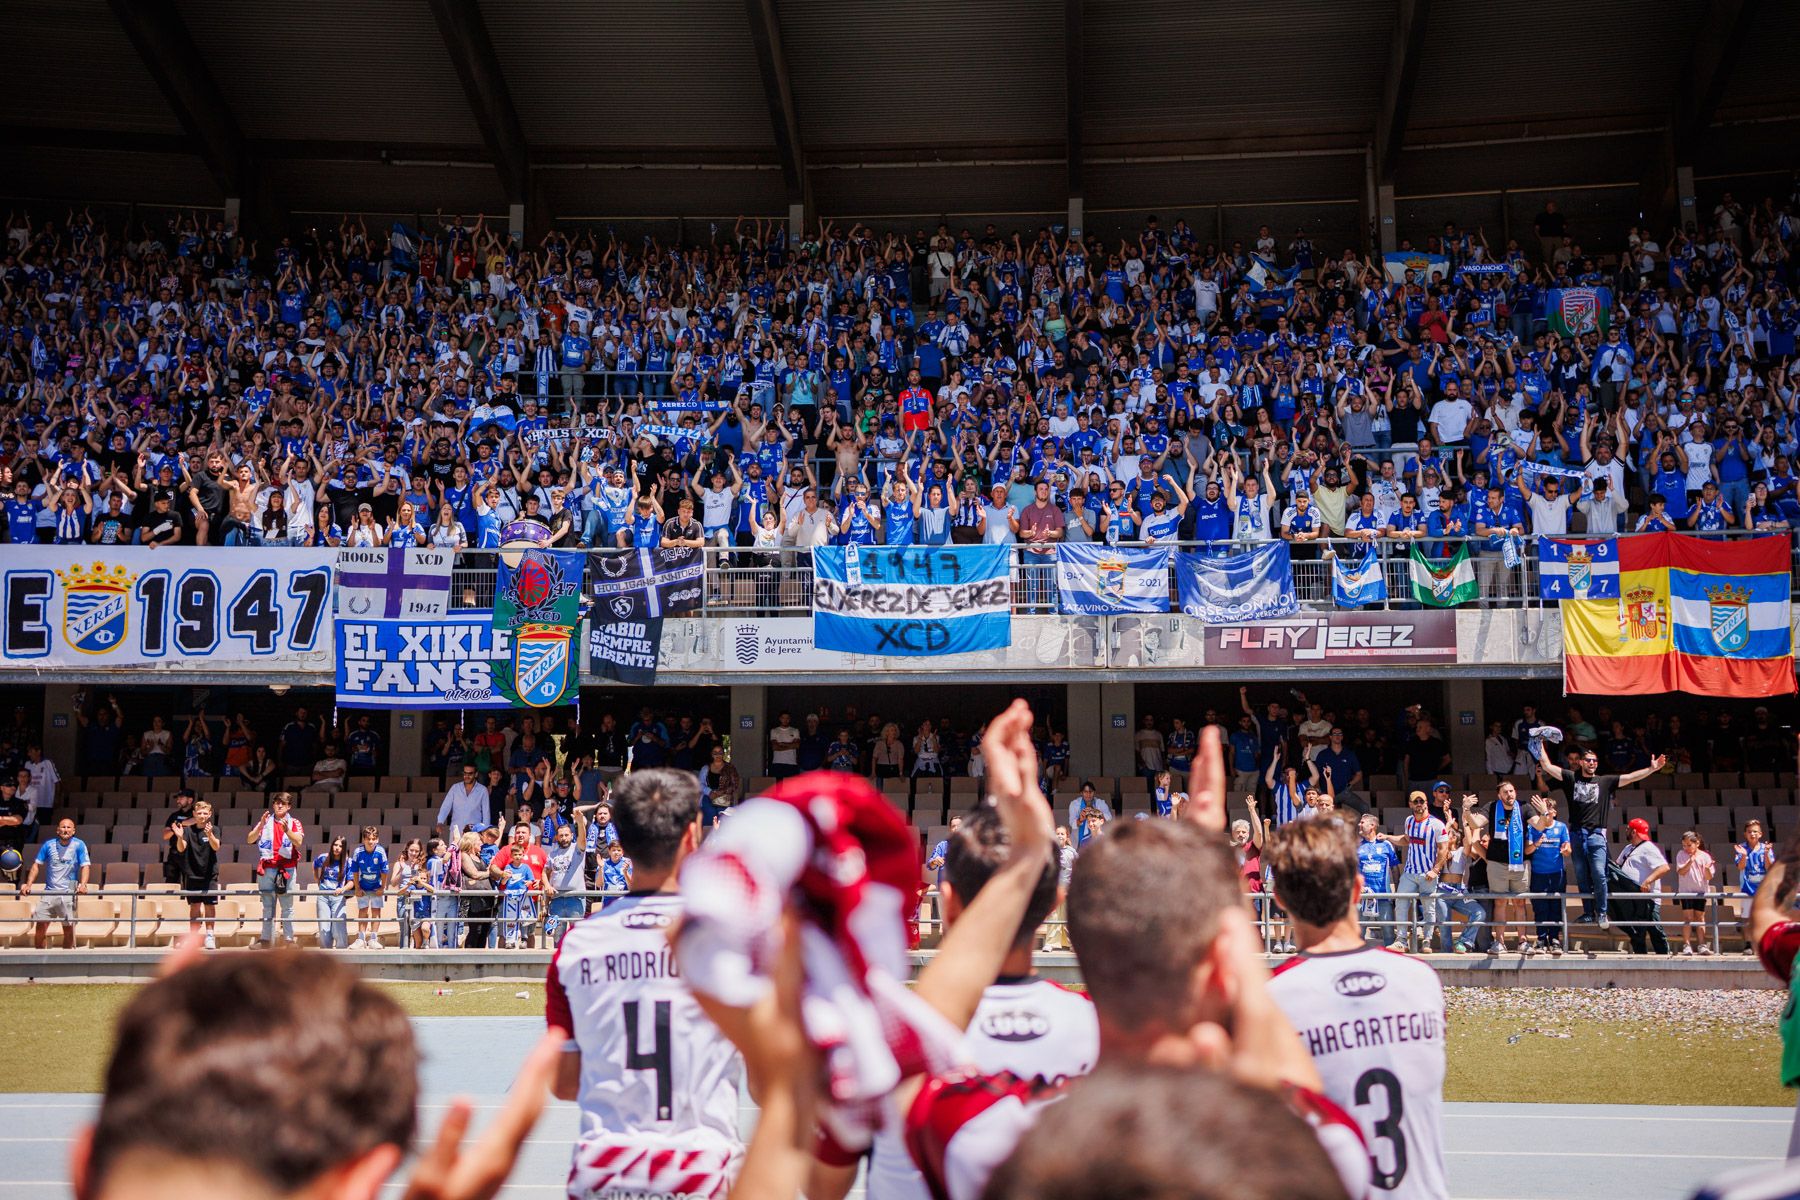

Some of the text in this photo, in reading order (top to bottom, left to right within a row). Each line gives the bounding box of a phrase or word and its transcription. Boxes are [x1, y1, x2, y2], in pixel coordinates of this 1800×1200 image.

[415, 553, 444, 566] XCD
[862, 551, 962, 583] 1947
[596, 576, 657, 593] HOOLIGANS
[1138, 578, 1161, 587] 2021
[5, 570, 53, 657] E
[73, 596, 123, 638] XEREZ
[136, 567, 332, 656] 1947
[408, 602, 440, 614] 1947
[531, 610, 561, 622] XCD
[1227, 600, 1264, 615] CON
[1716, 608, 1745, 639] XEREZ
[344, 624, 512, 660] EL XIKLE
[872, 622, 951, 651] XCD
[1219, 627, 1310, 649] PLAY
[765, 646, 802, 655] de Jerez
[345, 660, 492, 693] FANS
[522, 643, 565, 693] XEREZ
[400, 719, 413, 728] 139
[740, 720, 754, 728] 138
[1112, 719, 1126, 728] 138
[1338, 974, 1386, 994] LUGO
[623, 1001, 672, 1122] 4
[1354, 1067, 1408, 1191] 3
